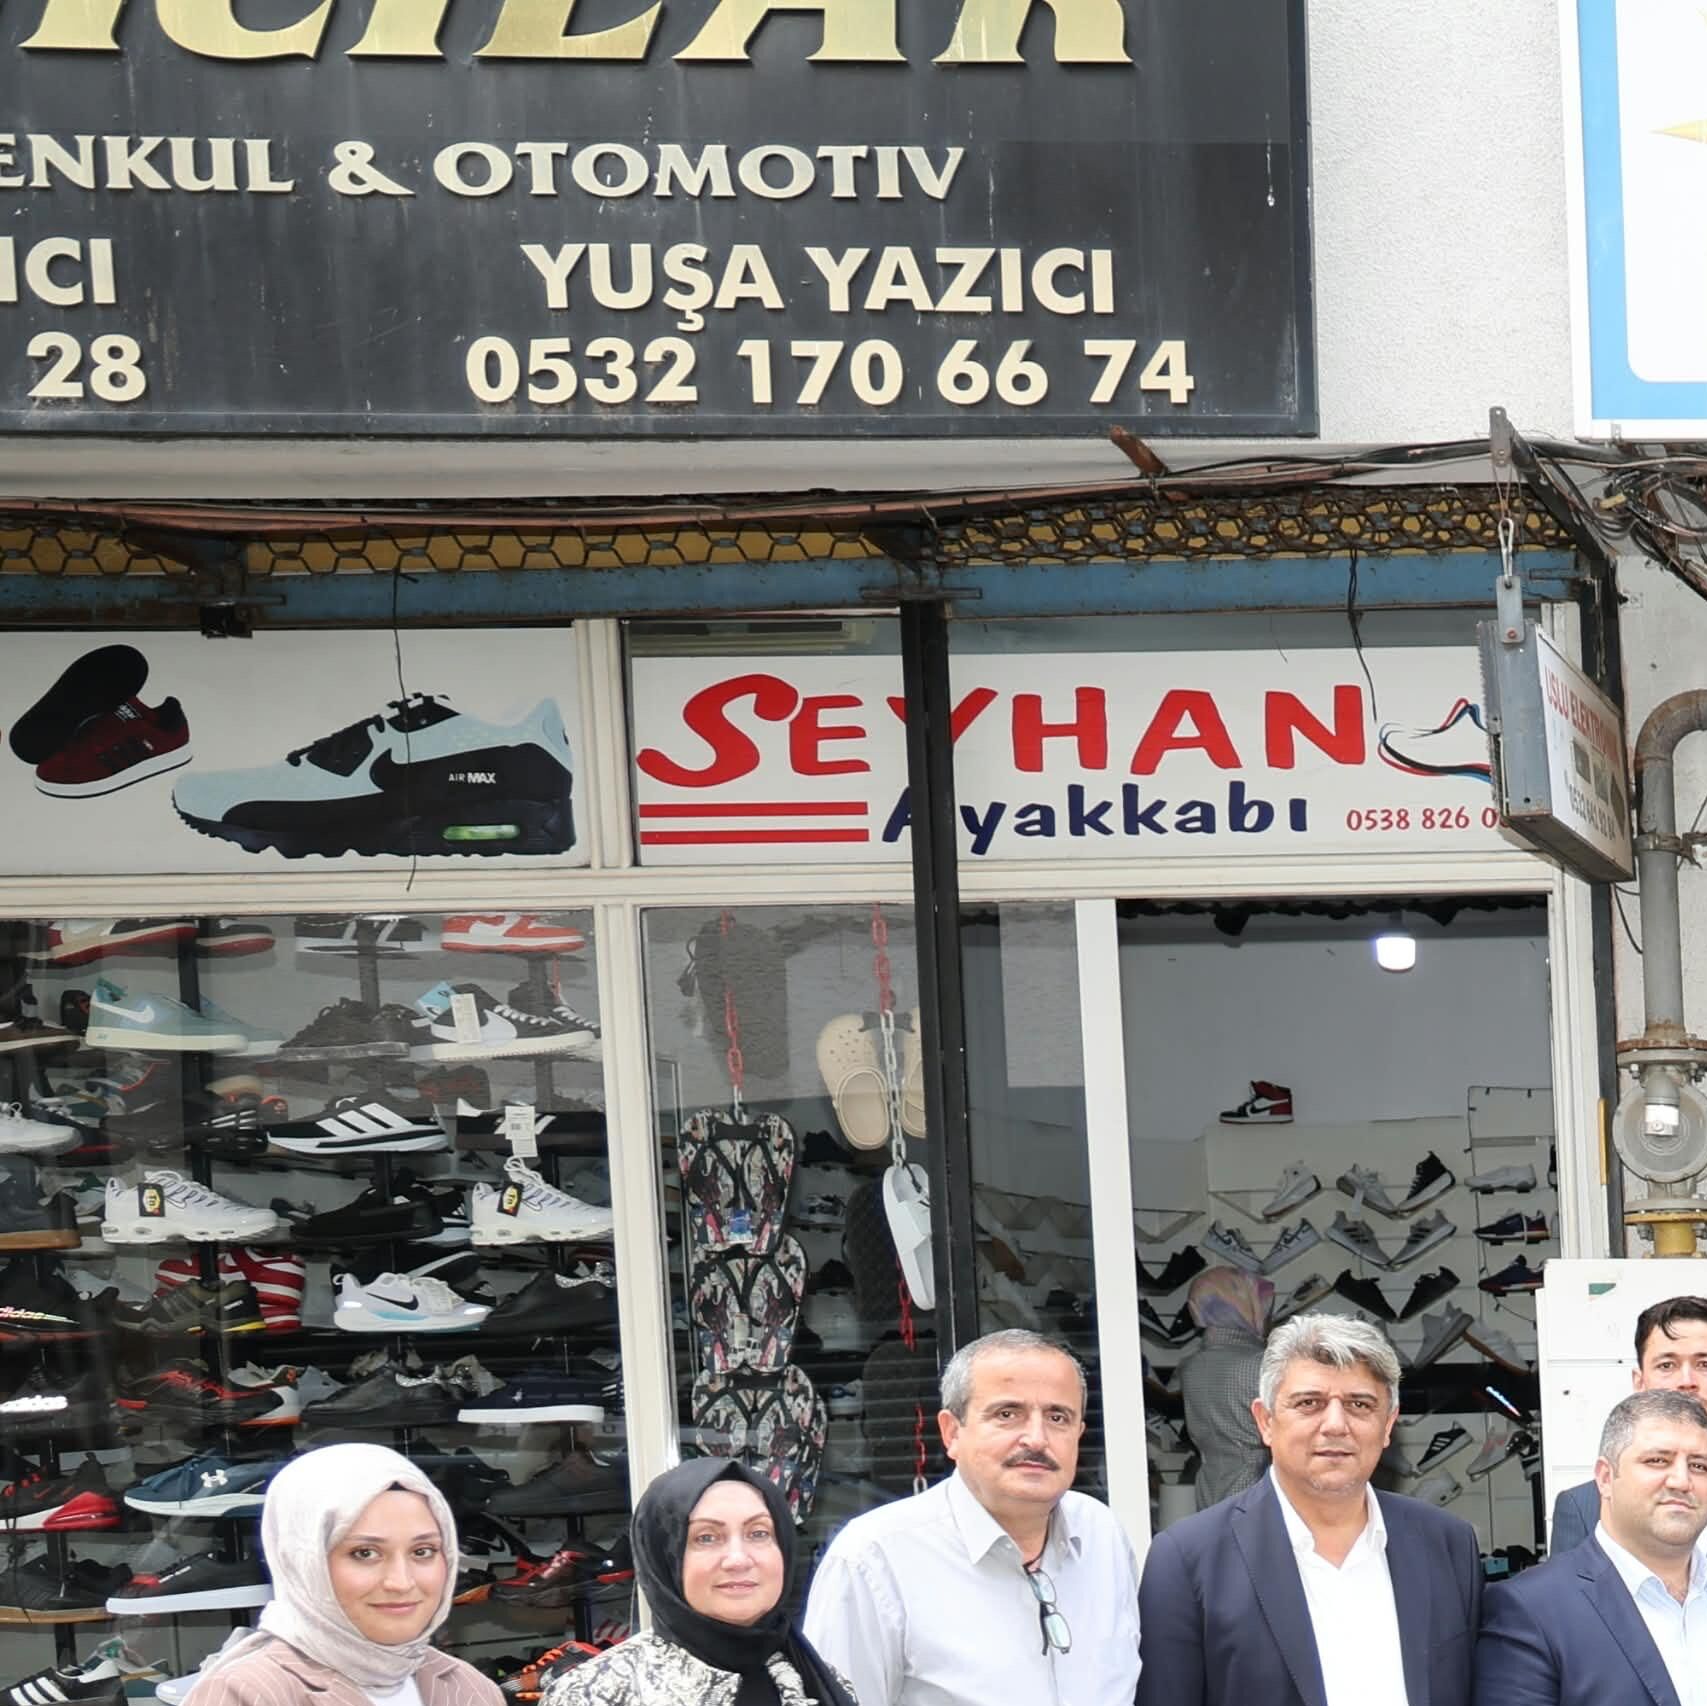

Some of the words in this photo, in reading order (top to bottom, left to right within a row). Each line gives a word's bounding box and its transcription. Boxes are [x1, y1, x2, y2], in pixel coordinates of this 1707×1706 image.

[328, 140, 416, 196] &
[433, 142, 967, 201] OTOMOTIV
[521, 243, 784, 332] YUŞA
[805, 245, 1116, 315] YAZICI
[26, 331, 147, 402] 28
[465, 336, 699, 405] 0532
[741, 338, 903, 406] 170
[936, 338, 1048, 406] 66
[1086, 338, 1195, 407] 74
[467, 772, 497, 784] MAX
[1346, 808, 1410, 830] 0538
[1422, 806, 1470, 829] 826
